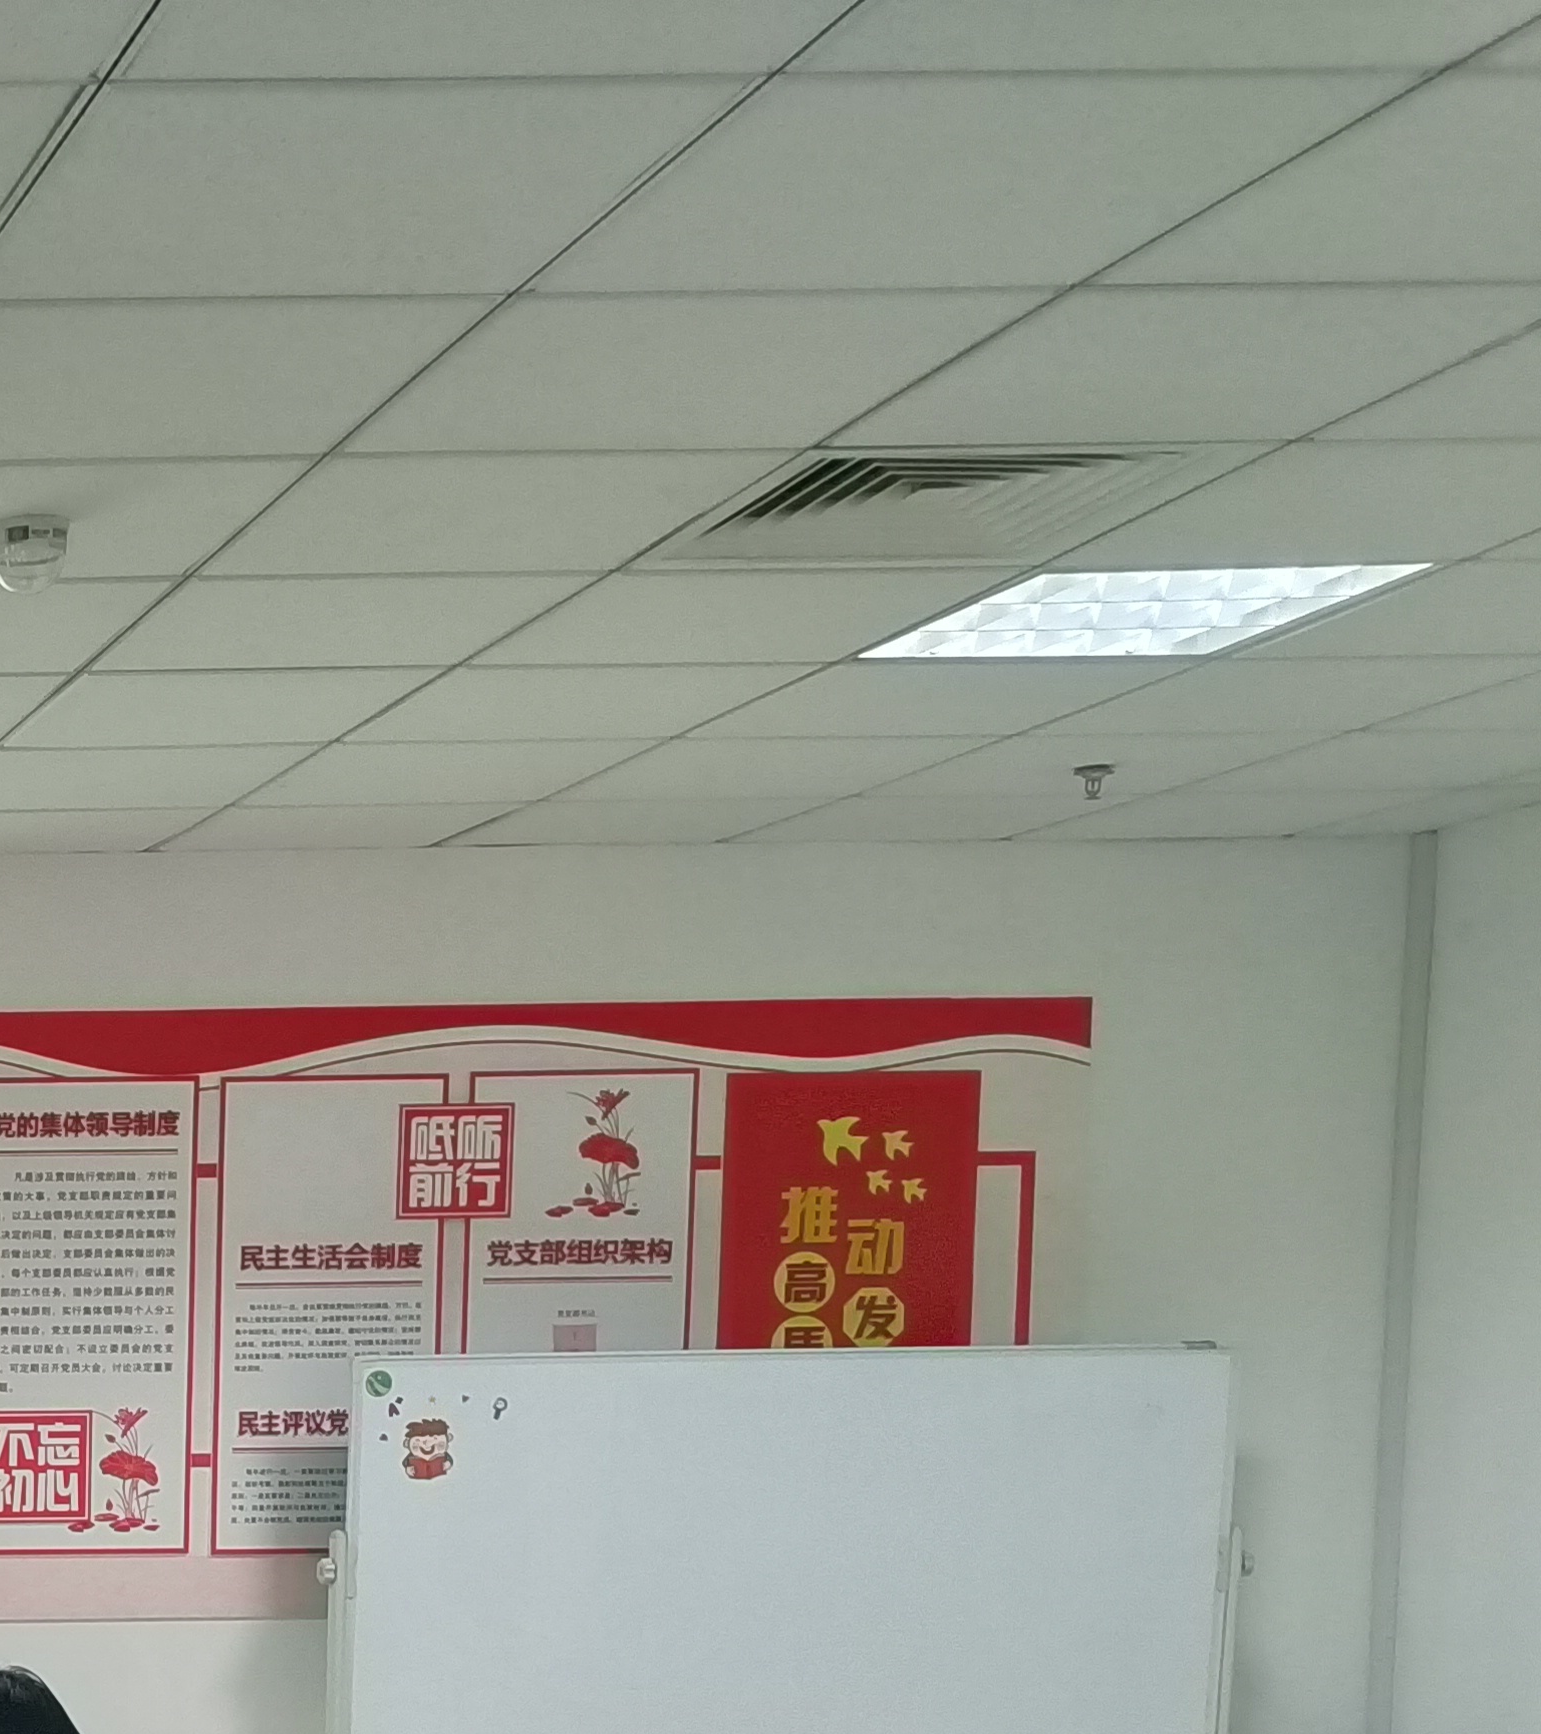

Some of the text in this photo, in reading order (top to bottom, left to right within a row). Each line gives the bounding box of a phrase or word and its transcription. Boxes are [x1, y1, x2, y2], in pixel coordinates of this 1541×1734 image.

[407, 1162, 502, 1208] 前行
[239, 1243, 424, 1271] 民主生活会制度
[486, 1238, 673, 1267] 党支部组织架构
[237, 1408, 348, 1437] 民主评议党
